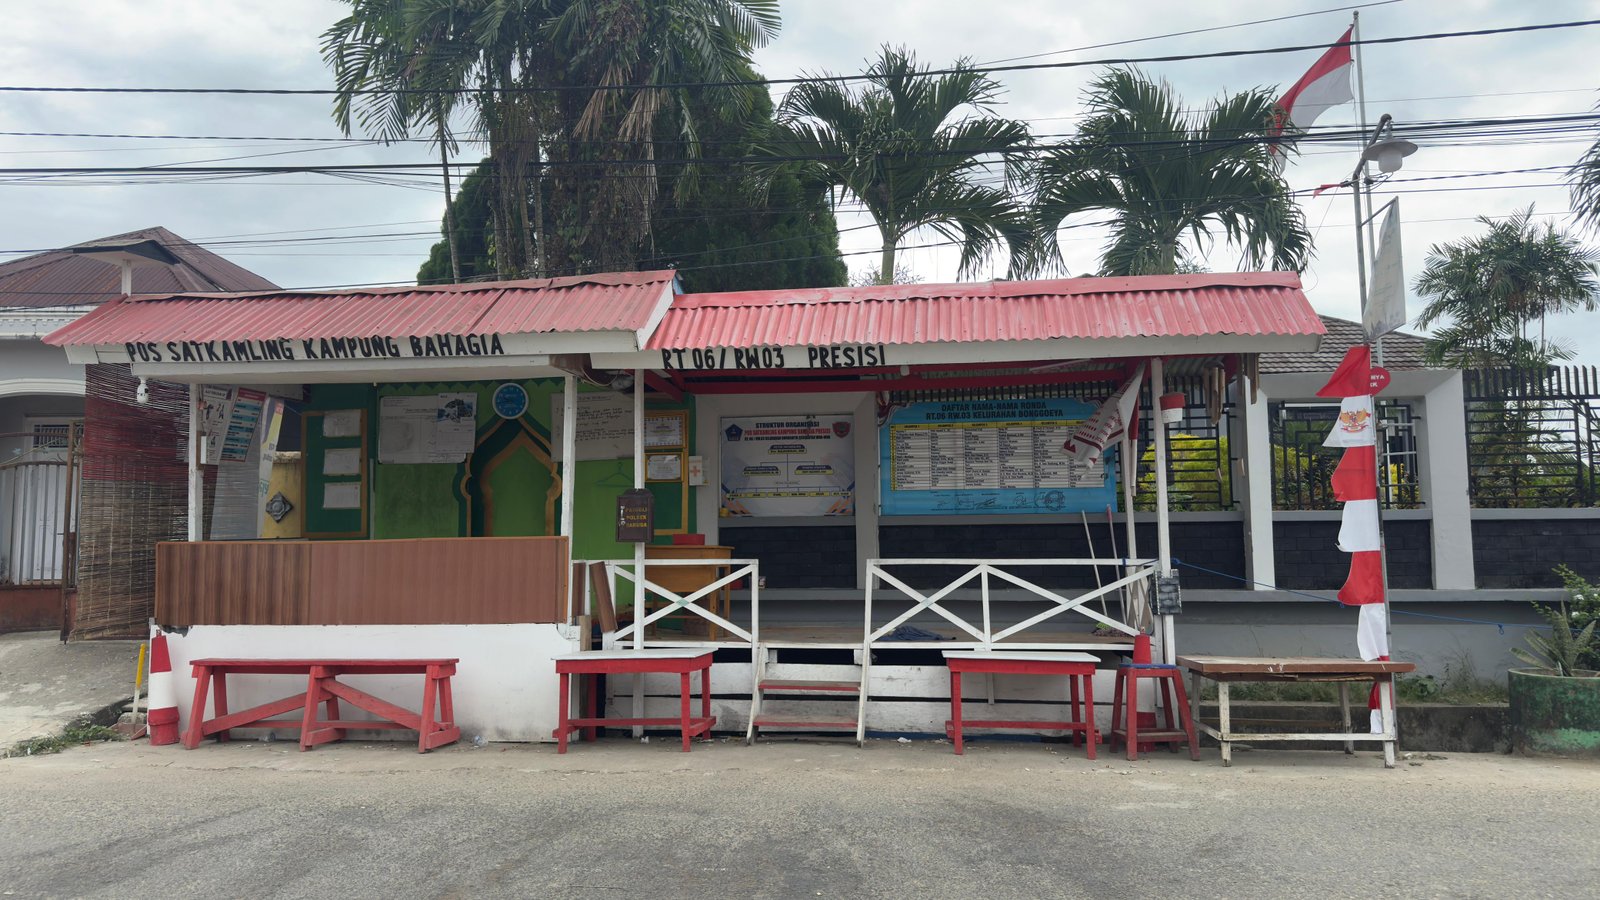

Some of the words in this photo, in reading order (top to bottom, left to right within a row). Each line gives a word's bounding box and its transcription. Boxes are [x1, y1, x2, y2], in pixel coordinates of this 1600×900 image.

[125, 341, 162, 361] POS
[167, 337, 294, 361] SATKAMLING
[302, 336, 400, 360] KAMPUNG
[410, 334, 504, 357] BAHAGIA
[661, 349, 687, 369] RT
[808, 345, 886, 368] PRESISI
[926, 412, 946, 420] RT.06
[948, 411, 971, 420] RW.03
[973, 410, 1016, 419] KELURAHAN
[1018, 409, 1063, 418] BONGGOEYA
[942, 404, 969, 412] DAFTAR
[972, 403, 1018, 411] NAMA-NAMA
[1021, 402, 1047, 410] RONDA
